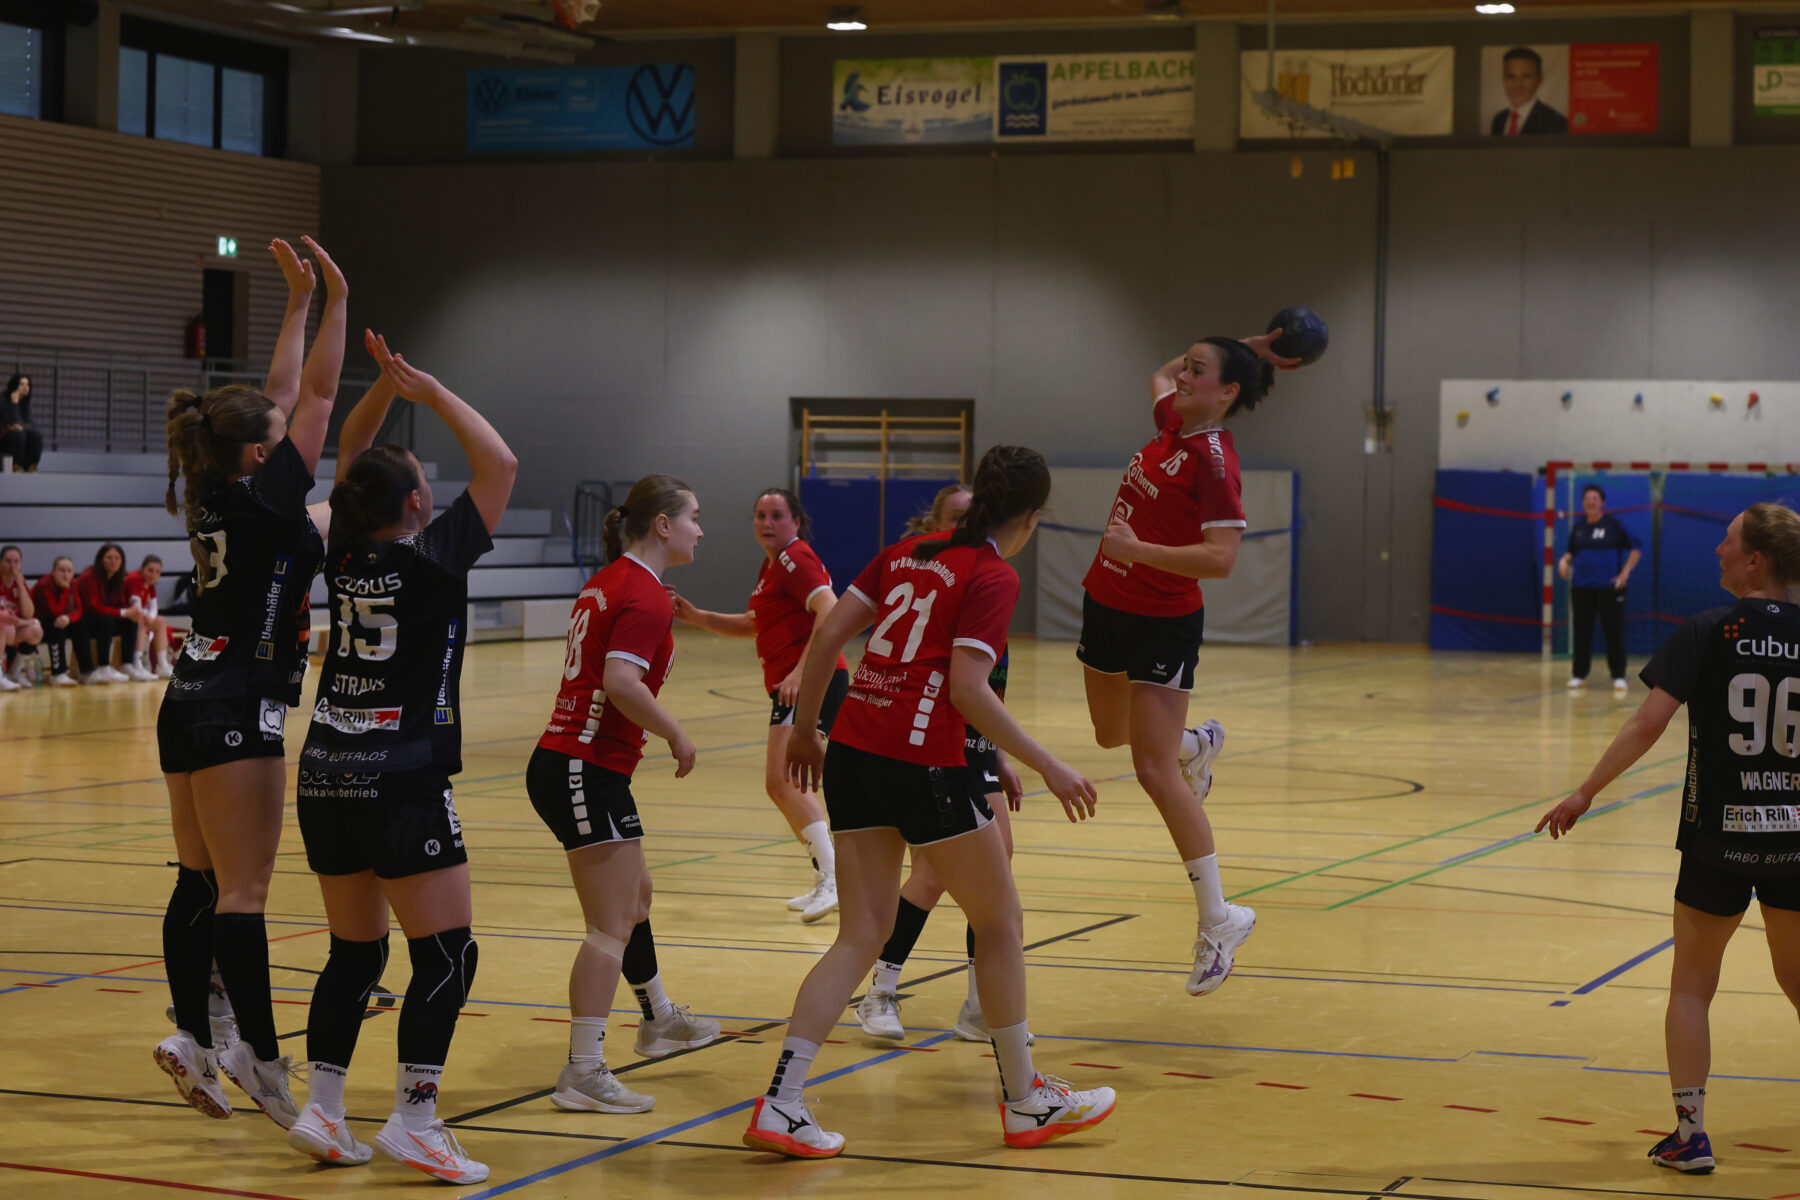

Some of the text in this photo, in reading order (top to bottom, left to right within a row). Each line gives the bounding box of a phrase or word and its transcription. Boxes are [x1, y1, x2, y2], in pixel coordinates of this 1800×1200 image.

[1051, 59, 1195, 81] APFELBACH
[877, 82, 982, 109] Eisvogel
[1160, 448, 1189, 477] 16
[261, 580, 283, 641] Ueltzhöfer
[867, 581, 937, 663] 21
[336, 594, 399, 662] 15
[1736, 635, 1800, 660] cubu
[1728, 672, 1800, 758] 96
[1740, 771, 1800, 791] WAGNER
[1725, 807, 1790, 822] Erich Rill
[1723, 848, 1760, 864] HABO
